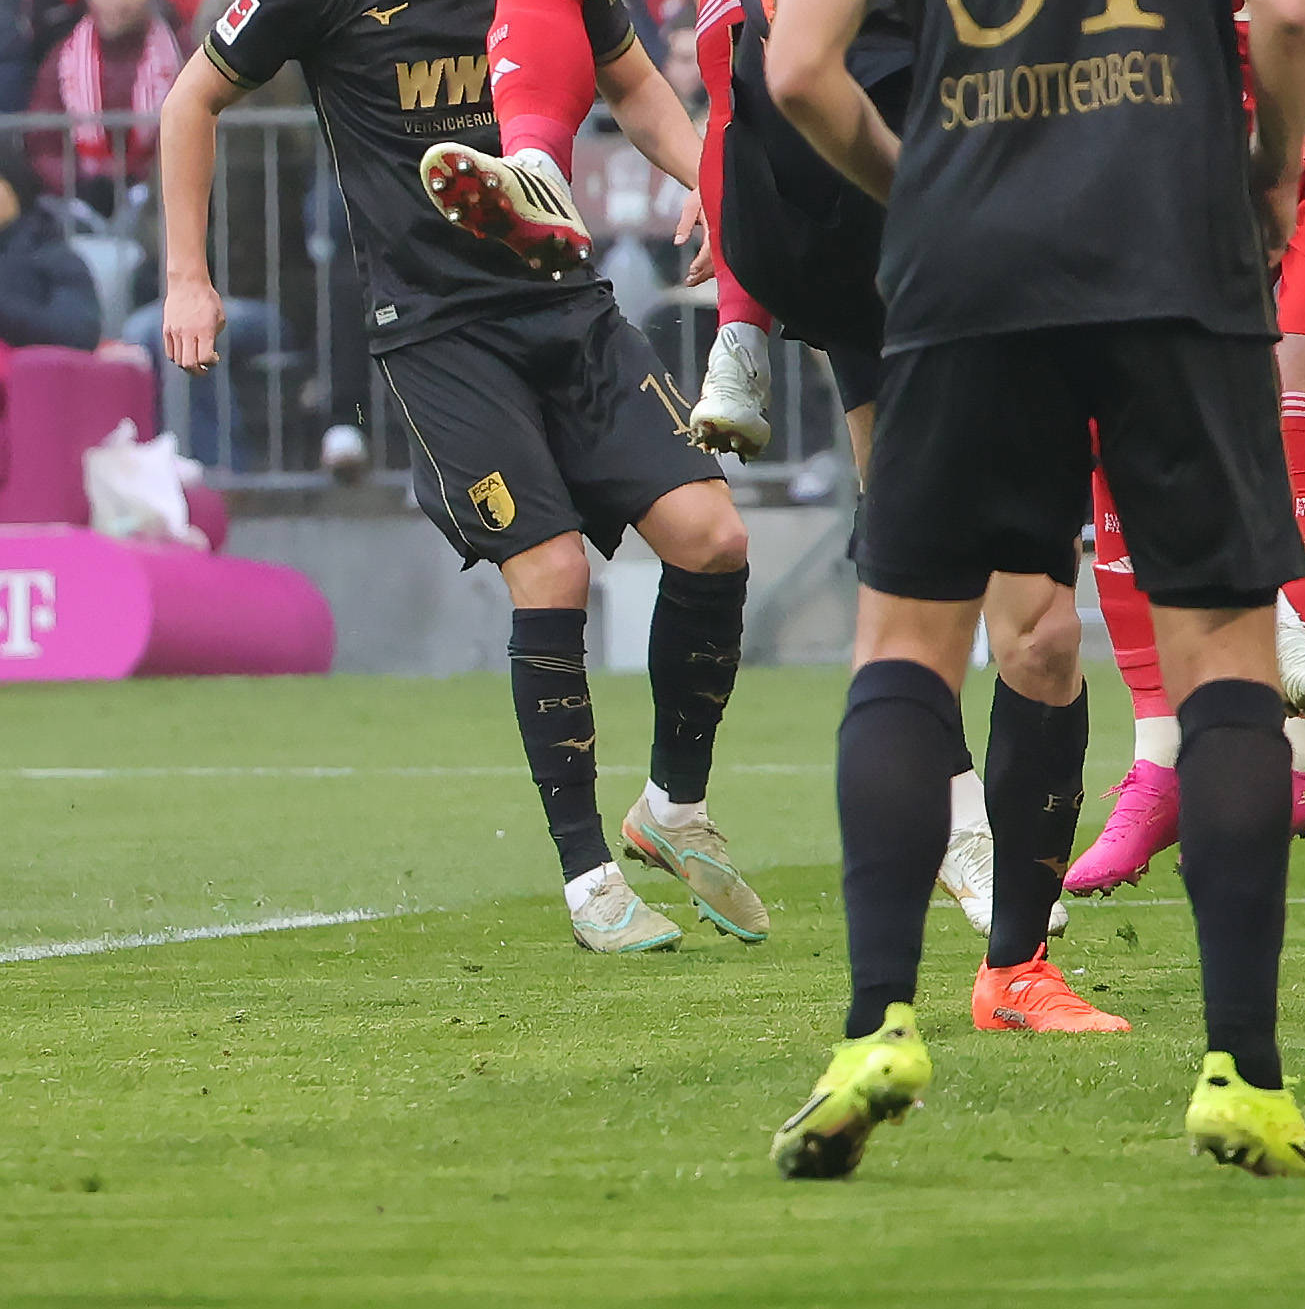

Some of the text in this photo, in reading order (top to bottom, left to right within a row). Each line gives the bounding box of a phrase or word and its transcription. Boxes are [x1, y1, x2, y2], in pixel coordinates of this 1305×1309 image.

[403, 111, 498, 133] VERSICHERU
[471, 477, 501, 498] FCA
[0, 568, 57, 660] T
